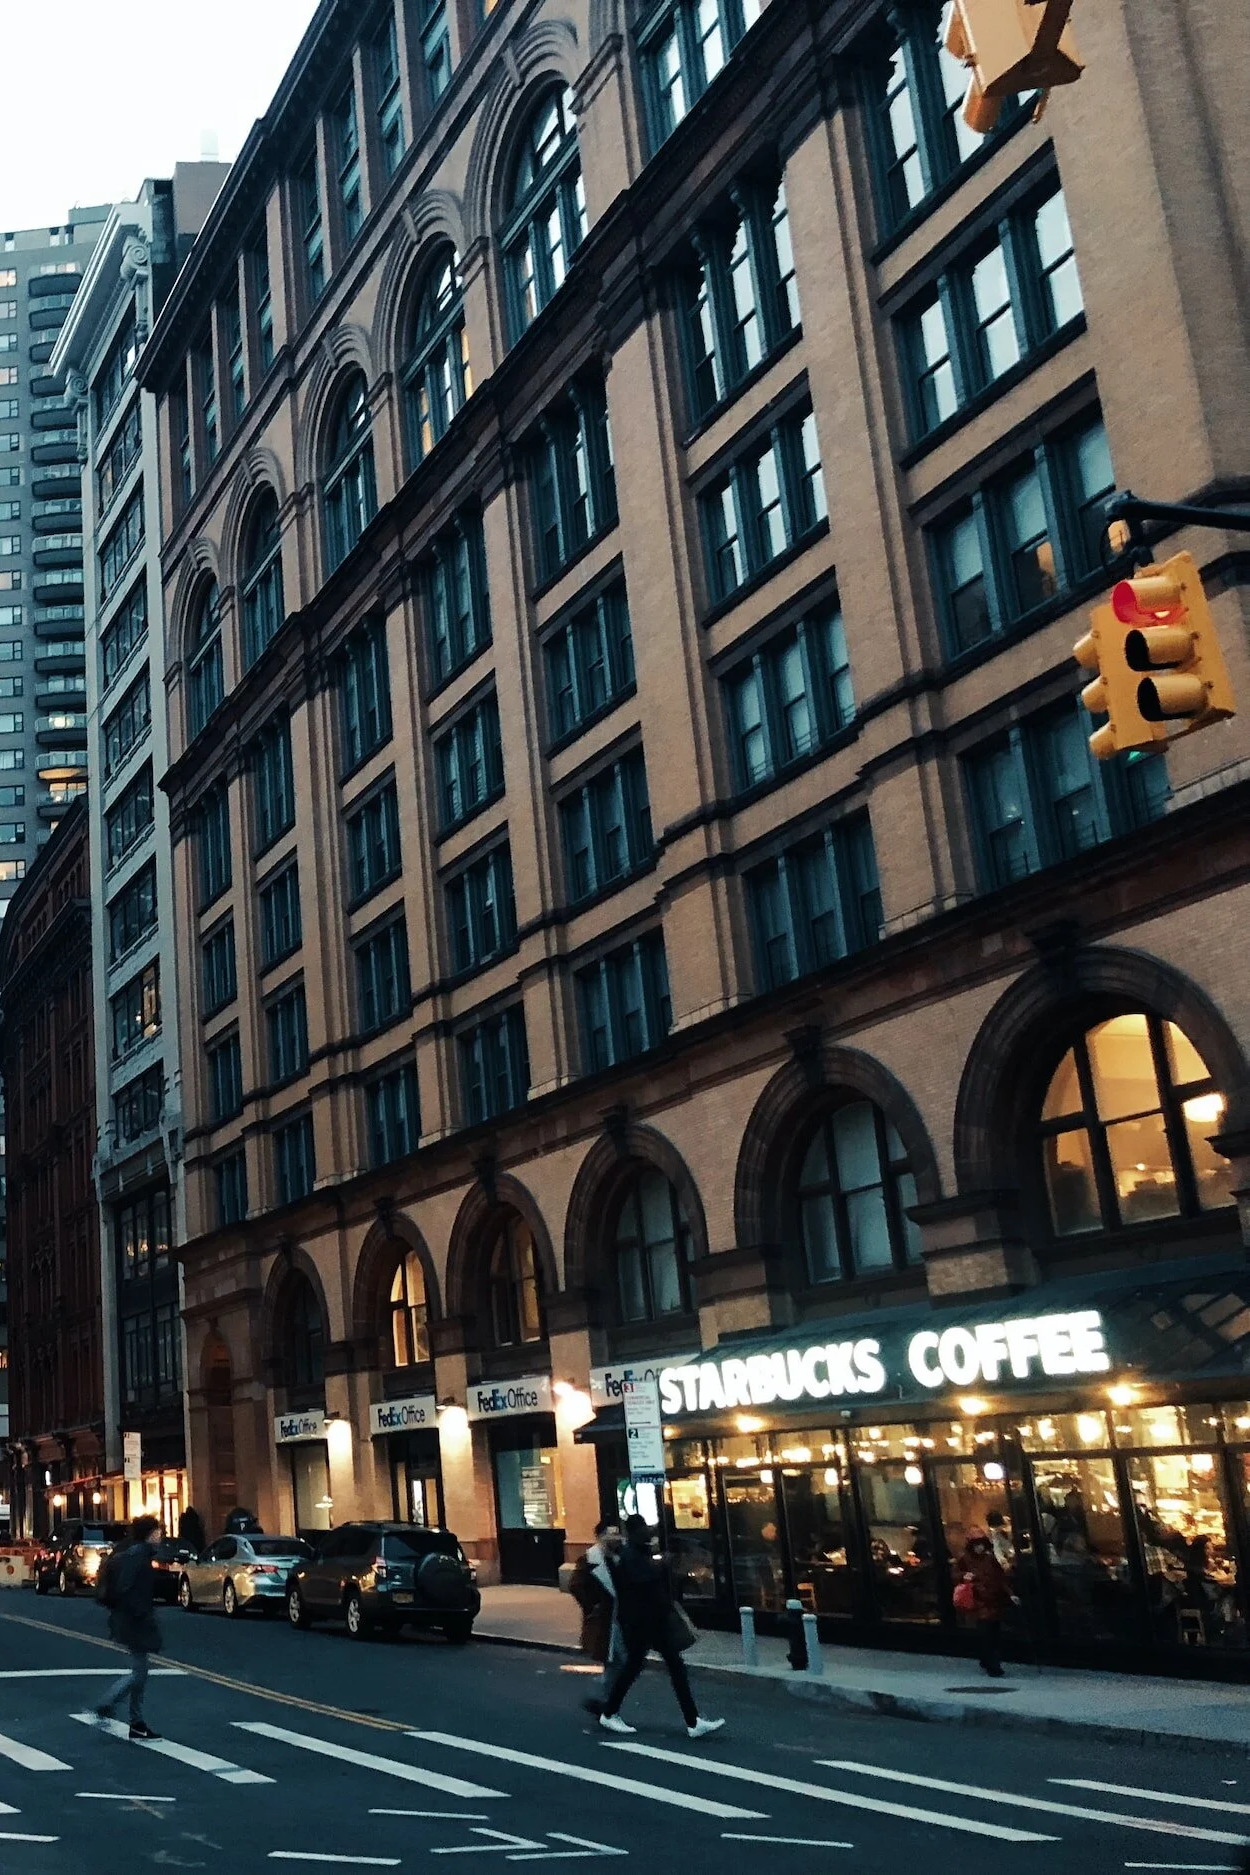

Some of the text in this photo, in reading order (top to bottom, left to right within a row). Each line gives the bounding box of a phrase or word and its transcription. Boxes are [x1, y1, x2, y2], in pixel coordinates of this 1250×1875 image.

[658, 1310, 1110, 1415] STARBUCKS COFFEE
[477, 1387, 538, 1412] FedEx Office
[280, 1416, 318, 1438] FedEx Office
[377, 1405, 426, 1428] FedEx Office
